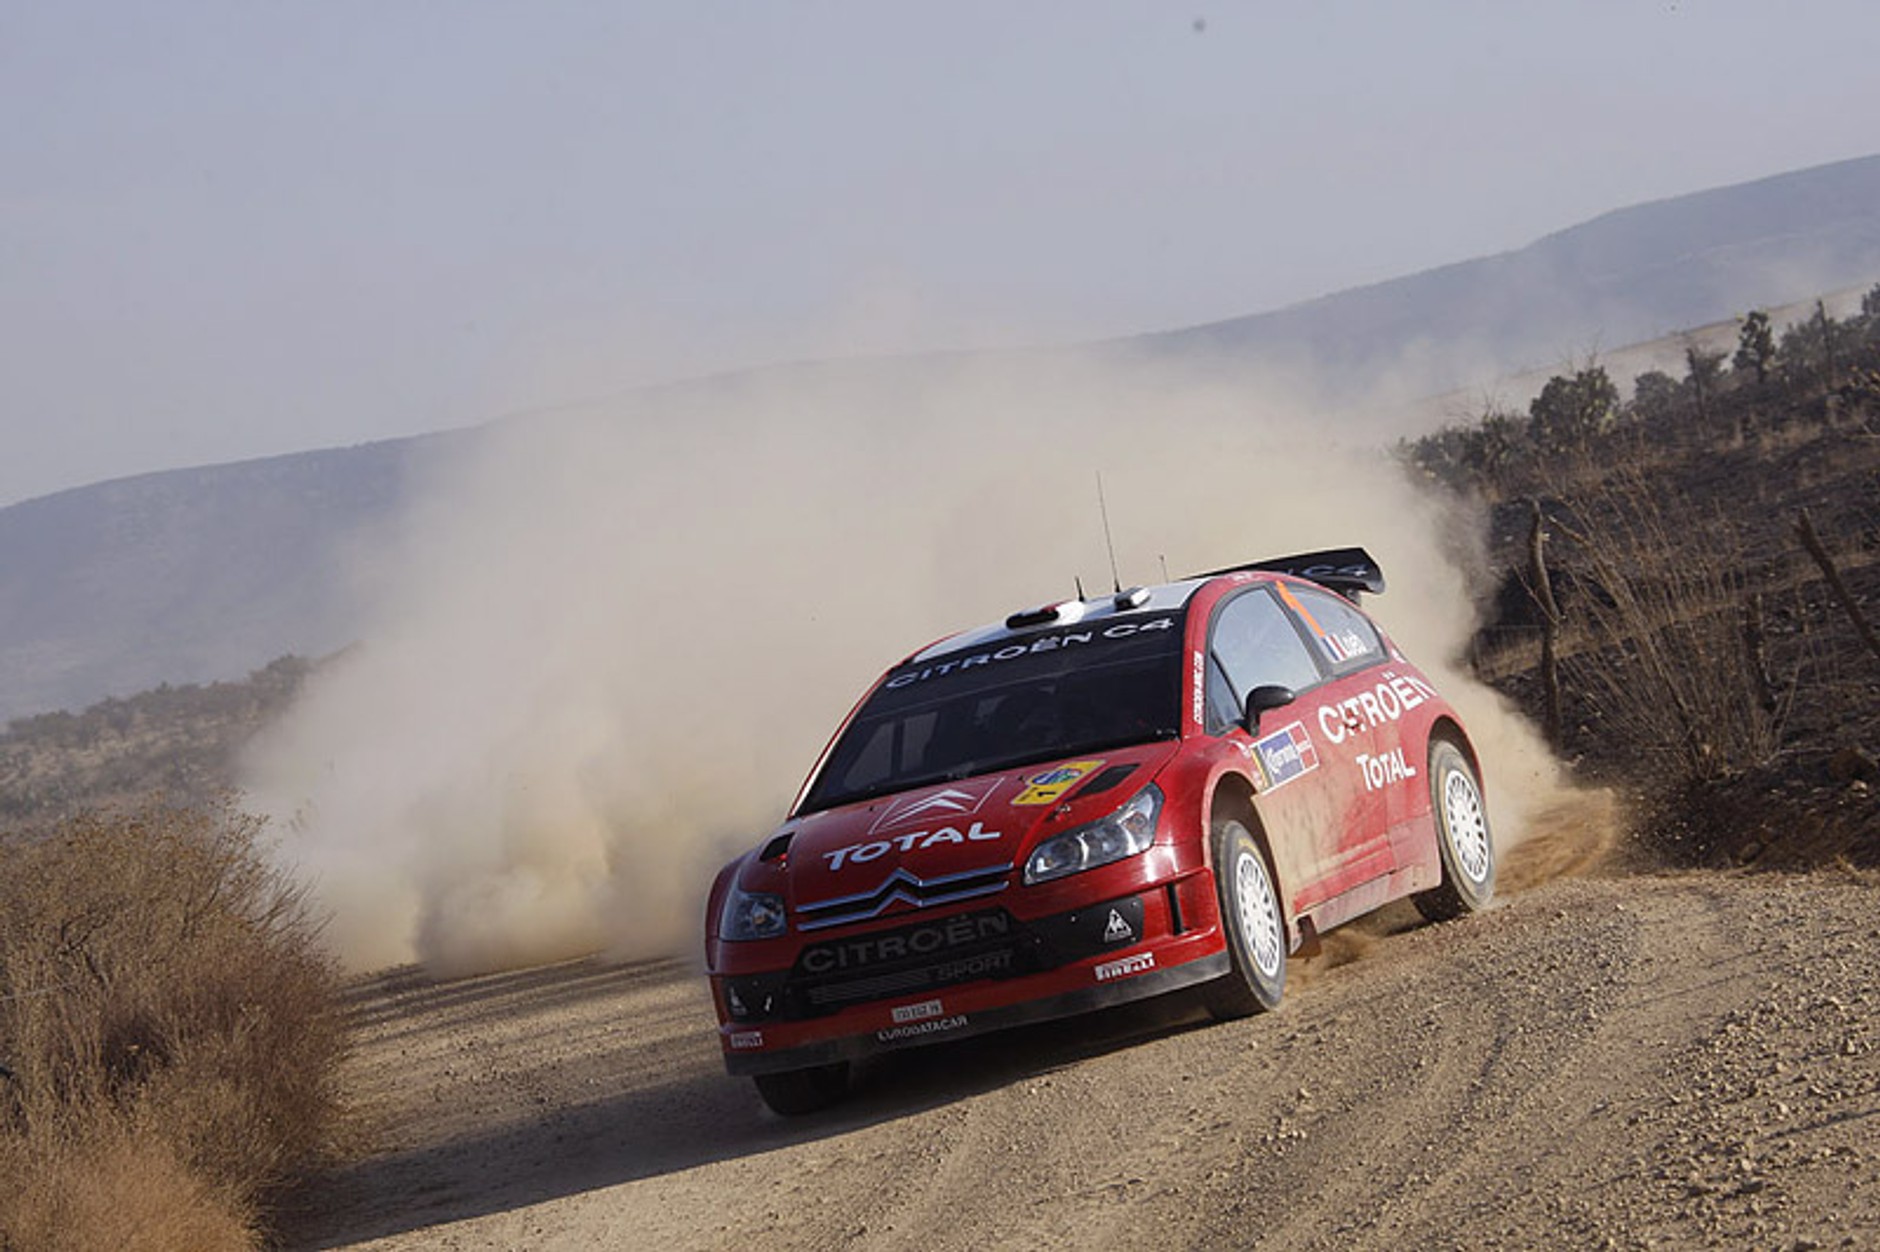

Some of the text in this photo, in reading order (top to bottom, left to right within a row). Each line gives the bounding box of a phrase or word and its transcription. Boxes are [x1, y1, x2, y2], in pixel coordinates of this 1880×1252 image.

[1103, 616, 1174, 639] C4
[1318, 670, 1437, 745] CITROËN
[823, 822, 1001, 871] TOTAL
[803, 912, 1008, 972] CITROËN
